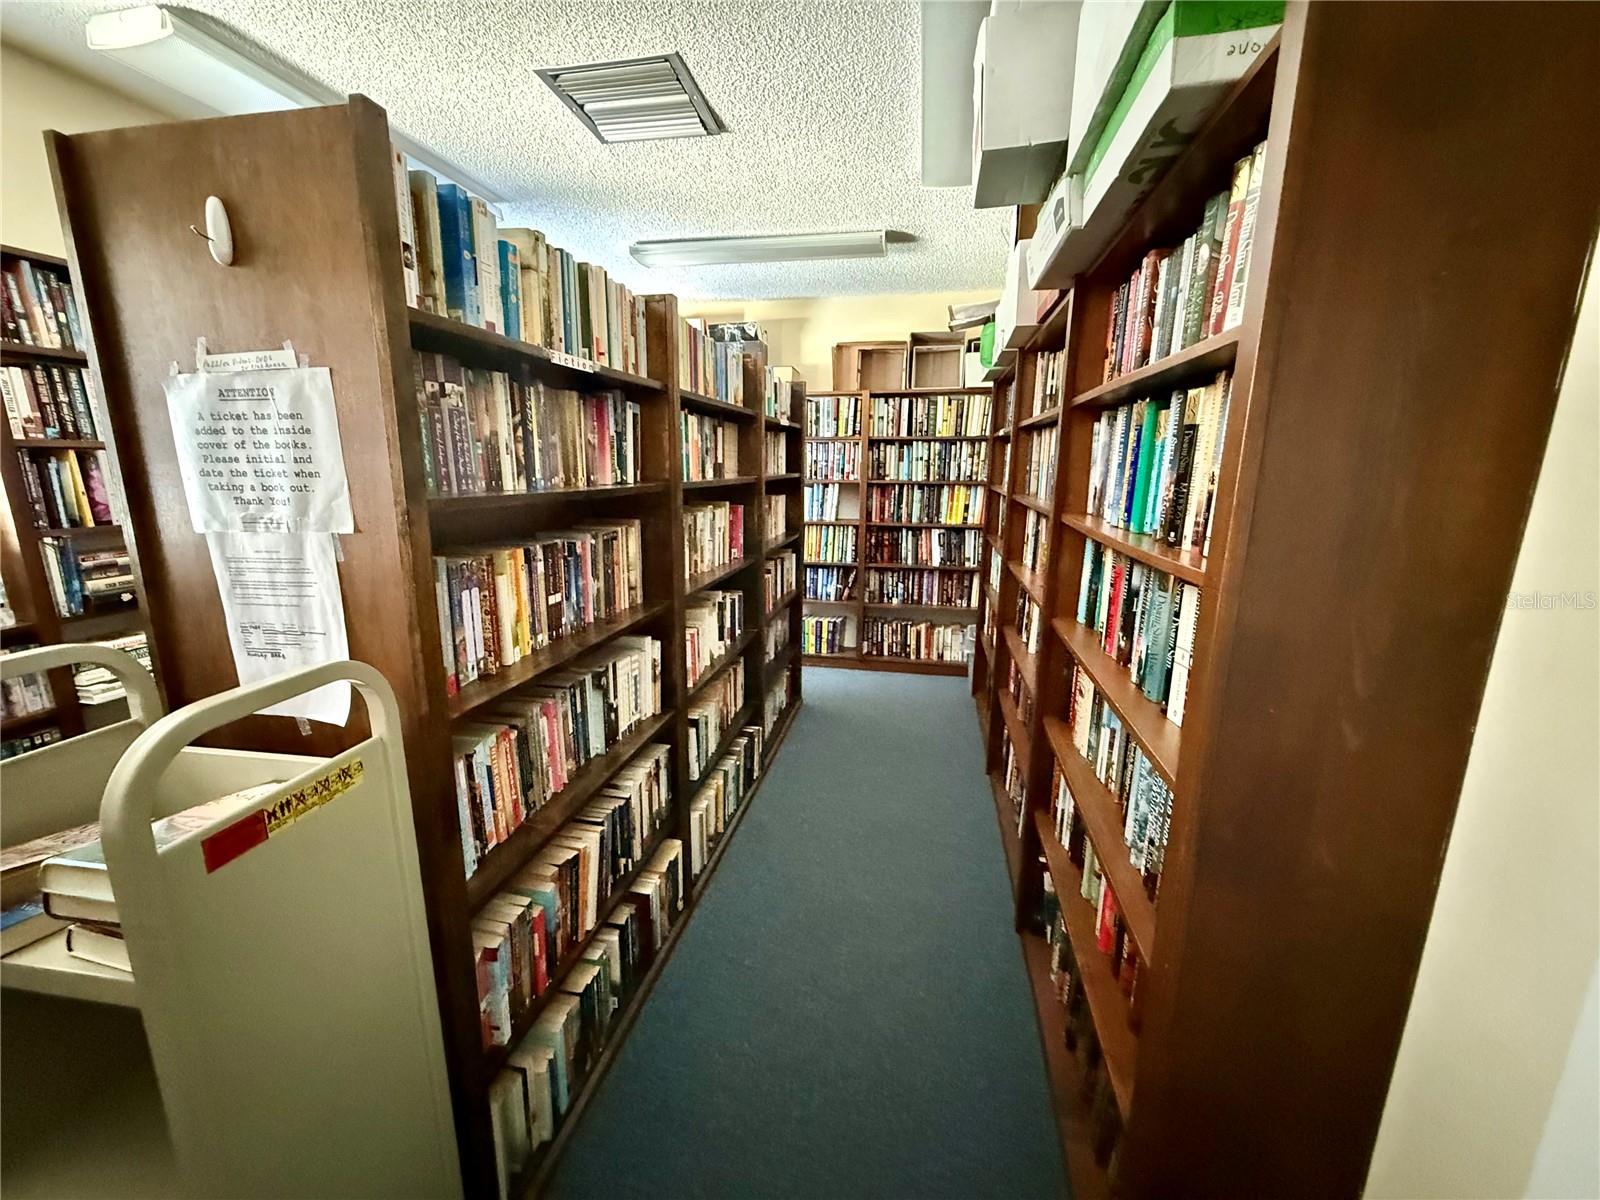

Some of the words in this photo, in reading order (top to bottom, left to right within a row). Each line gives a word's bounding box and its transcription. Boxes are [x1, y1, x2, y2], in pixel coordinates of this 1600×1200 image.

[550, 351, 593, 371] Fiction
[198, 412, 204, 421] A
[211, 412, 248, 421] ticket
[254, 412, 272, 420] has
[277, 411, 303, 420] been
[195, 426, 226, 436] added
[232, 427, 245, 436] to
[250, 426, 268, 435] the
[273, 427, 312, 435] inside
[234, 441, 246, 449] of
[253, 441, 270, 449] the
[202, 455, 240, 464] Please
[245, 455, 286, 464] initial
[292, 455, 313, 464] and
[230, 469, 248, 477] the
[254, 470, 288, 478] ticket
[294, 470, 321, 479] when
[208, 483, 245, 493] taking
[290, 485, 315, 493] out.
[233, 497, 264, 505] Thank
[269, 497, 291, 506] You!
